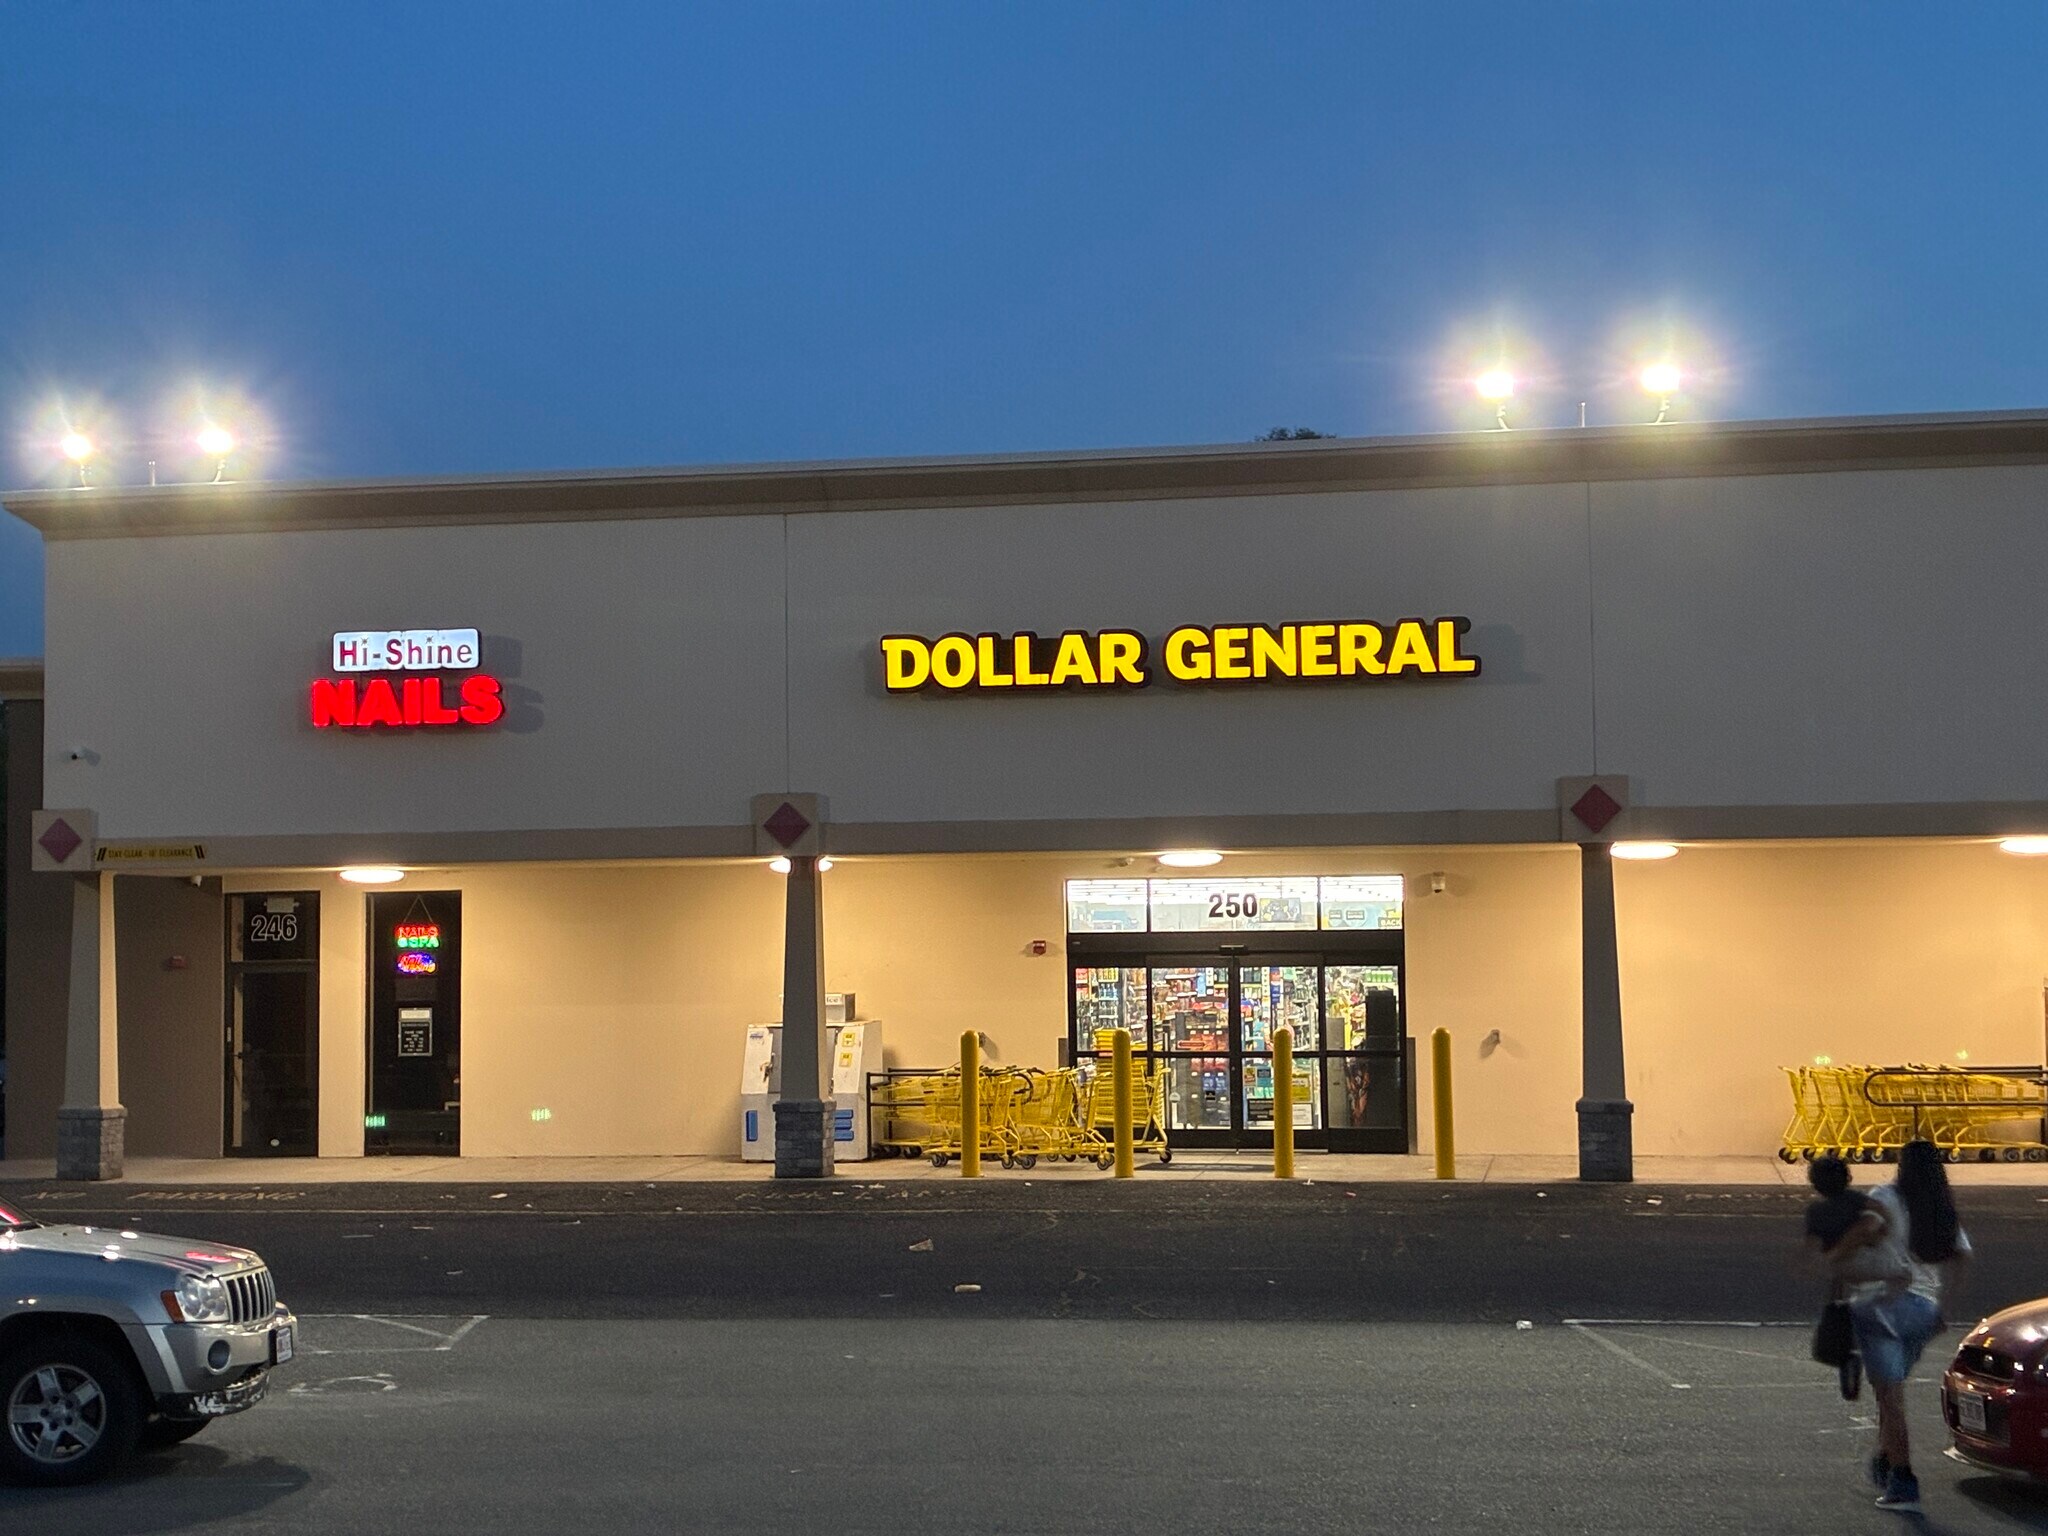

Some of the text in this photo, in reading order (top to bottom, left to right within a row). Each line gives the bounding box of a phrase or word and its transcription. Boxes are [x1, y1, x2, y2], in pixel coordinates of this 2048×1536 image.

[339, 636, 472, 668] Hi-Shine
[881, 621, 1476, 689] DOLLAR GENERAL
[312, 675, 503, 728] NAILS
[1208, 893, 1258, 918] 250
[250, 914, 297, 941] 246
[397, 926, 438, 938] NAILS
[1380, 918, 1401, 928] BACK
